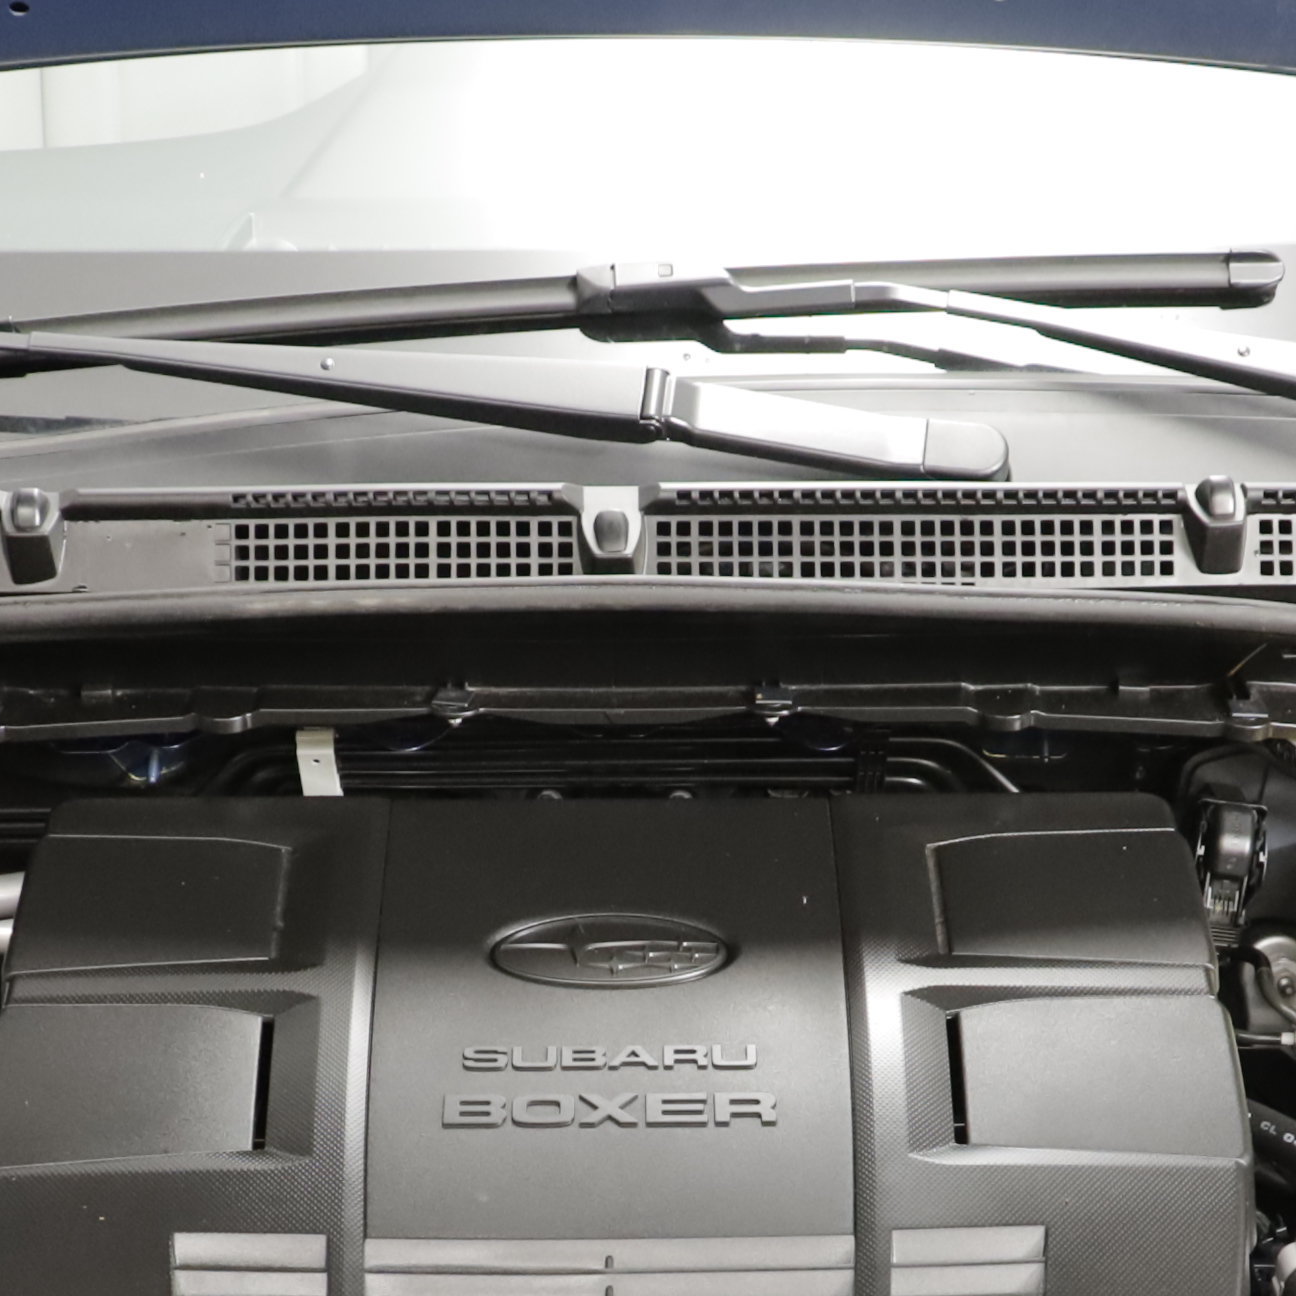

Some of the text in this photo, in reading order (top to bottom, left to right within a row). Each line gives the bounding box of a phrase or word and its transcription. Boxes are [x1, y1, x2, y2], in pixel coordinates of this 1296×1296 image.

[462, 1044, 757, 1071] SUBARU
[442, 1091, 777, 1128] BOXER
[1260, 1121, 1277, 1136] CL
